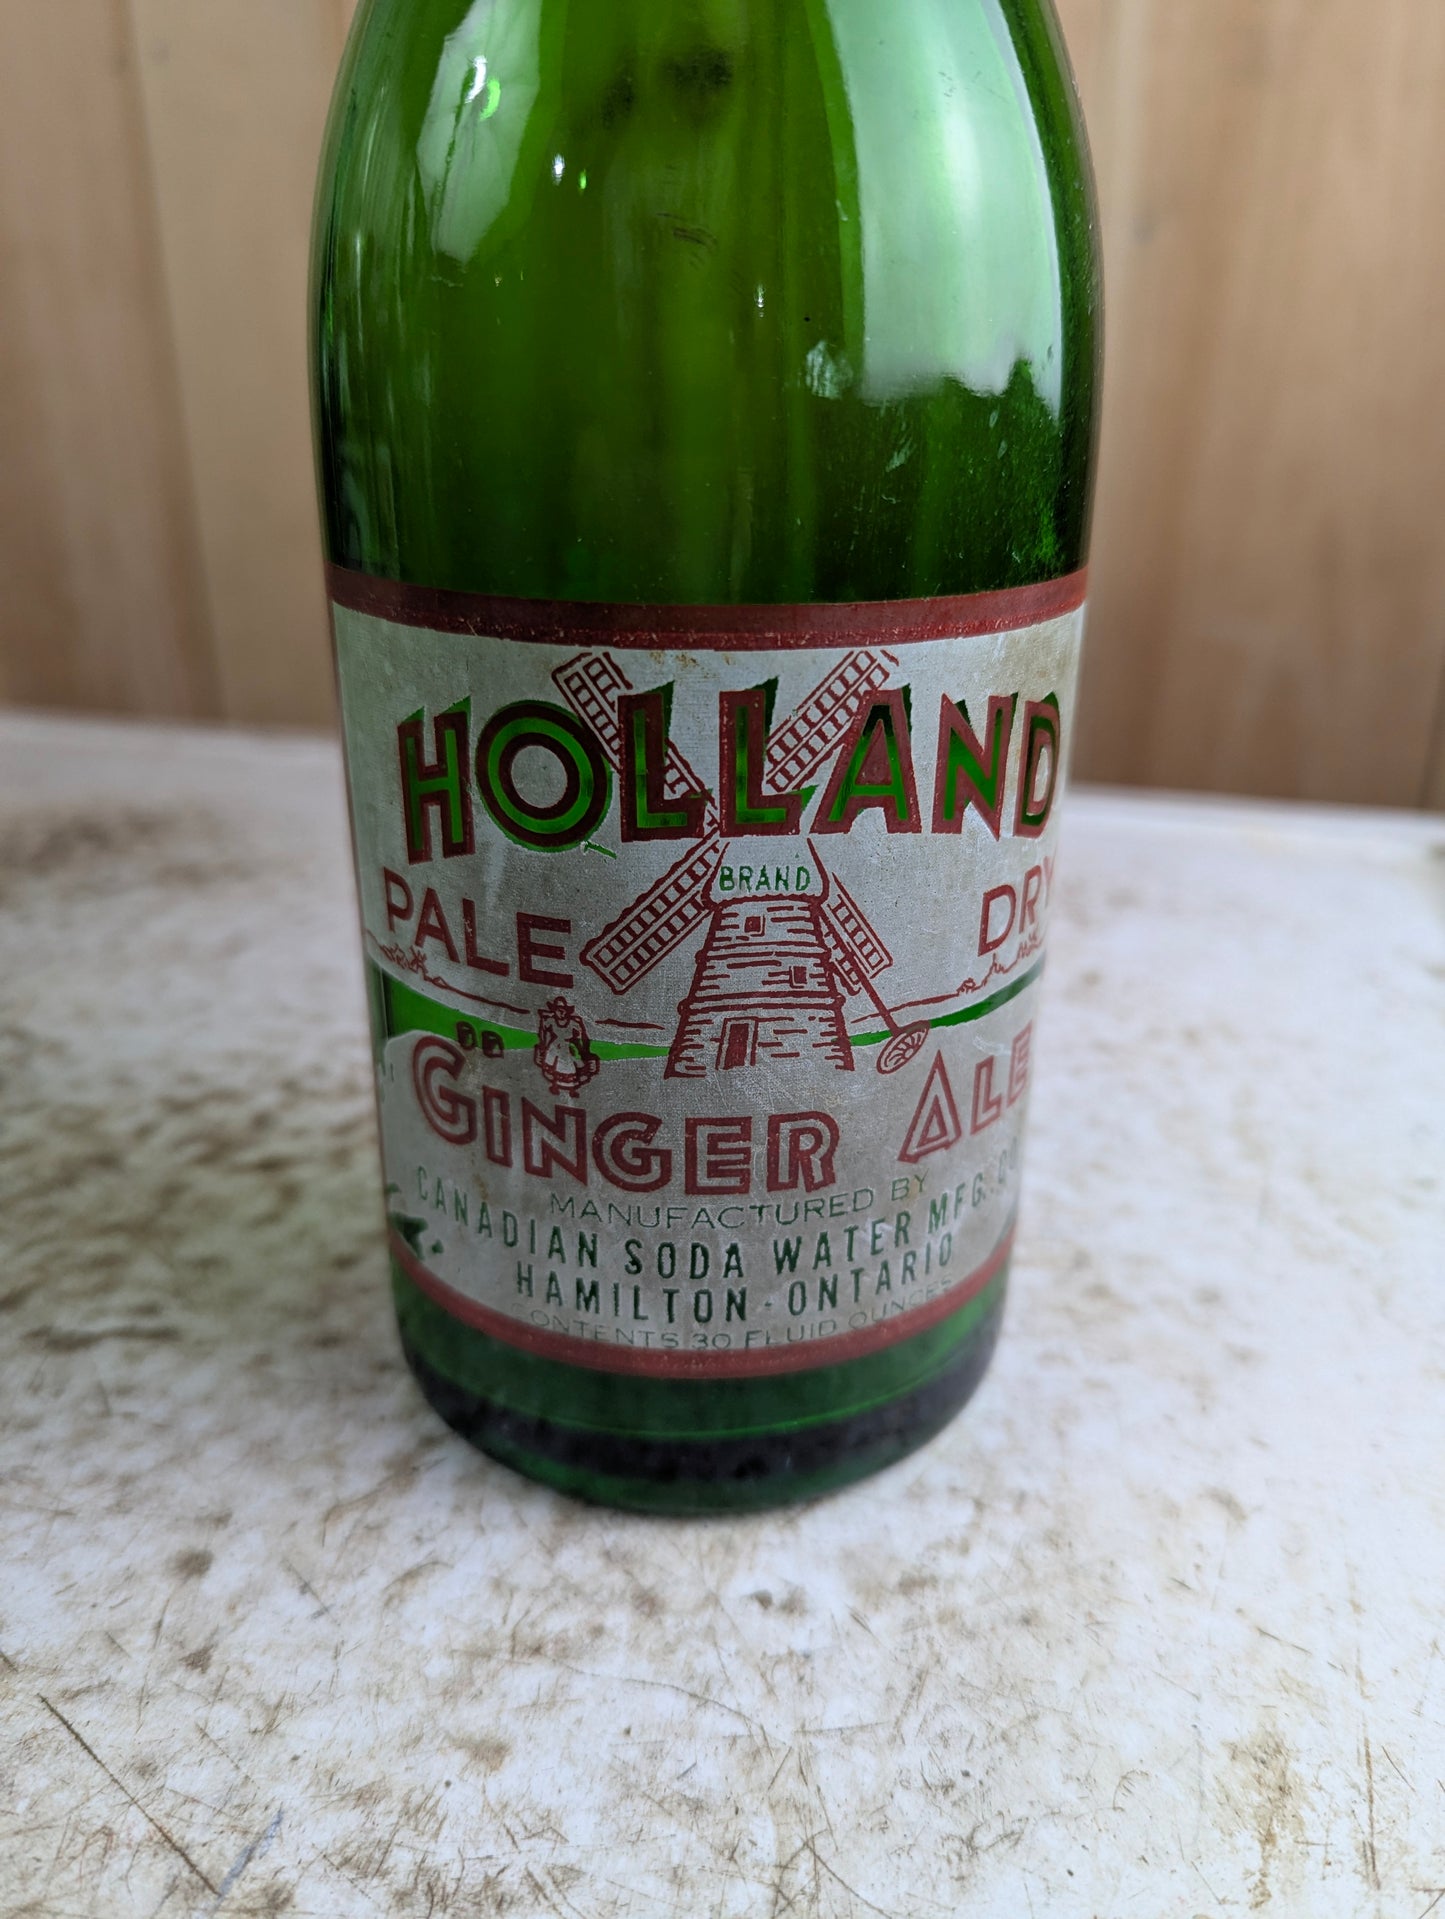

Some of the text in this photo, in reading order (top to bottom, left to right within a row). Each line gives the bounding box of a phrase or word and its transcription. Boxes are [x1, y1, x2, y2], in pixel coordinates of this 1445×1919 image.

[397, 676, 1060, 866] HOLLAND
[383, 846, 1057, 990] PALE DRY
[719, 864, 812, 893] BRAND
[412, 1020, 1033, 1194] GINGER ALE
[417, 1165, 599, 1268] CANADIAN
[624, 1238, 744, 1280] SODA
[772, 1210, 912, 1276] WATER
[551, 1168, 930, 1230] MANUFACTURED BY
[516, 1260, 748, 1324] HAMILTON
[787, 1230, 953, 1317] ONTARIO
[692, 1333, 732, 1350] 30
[745, 1319, 838, 1350] FLUID
